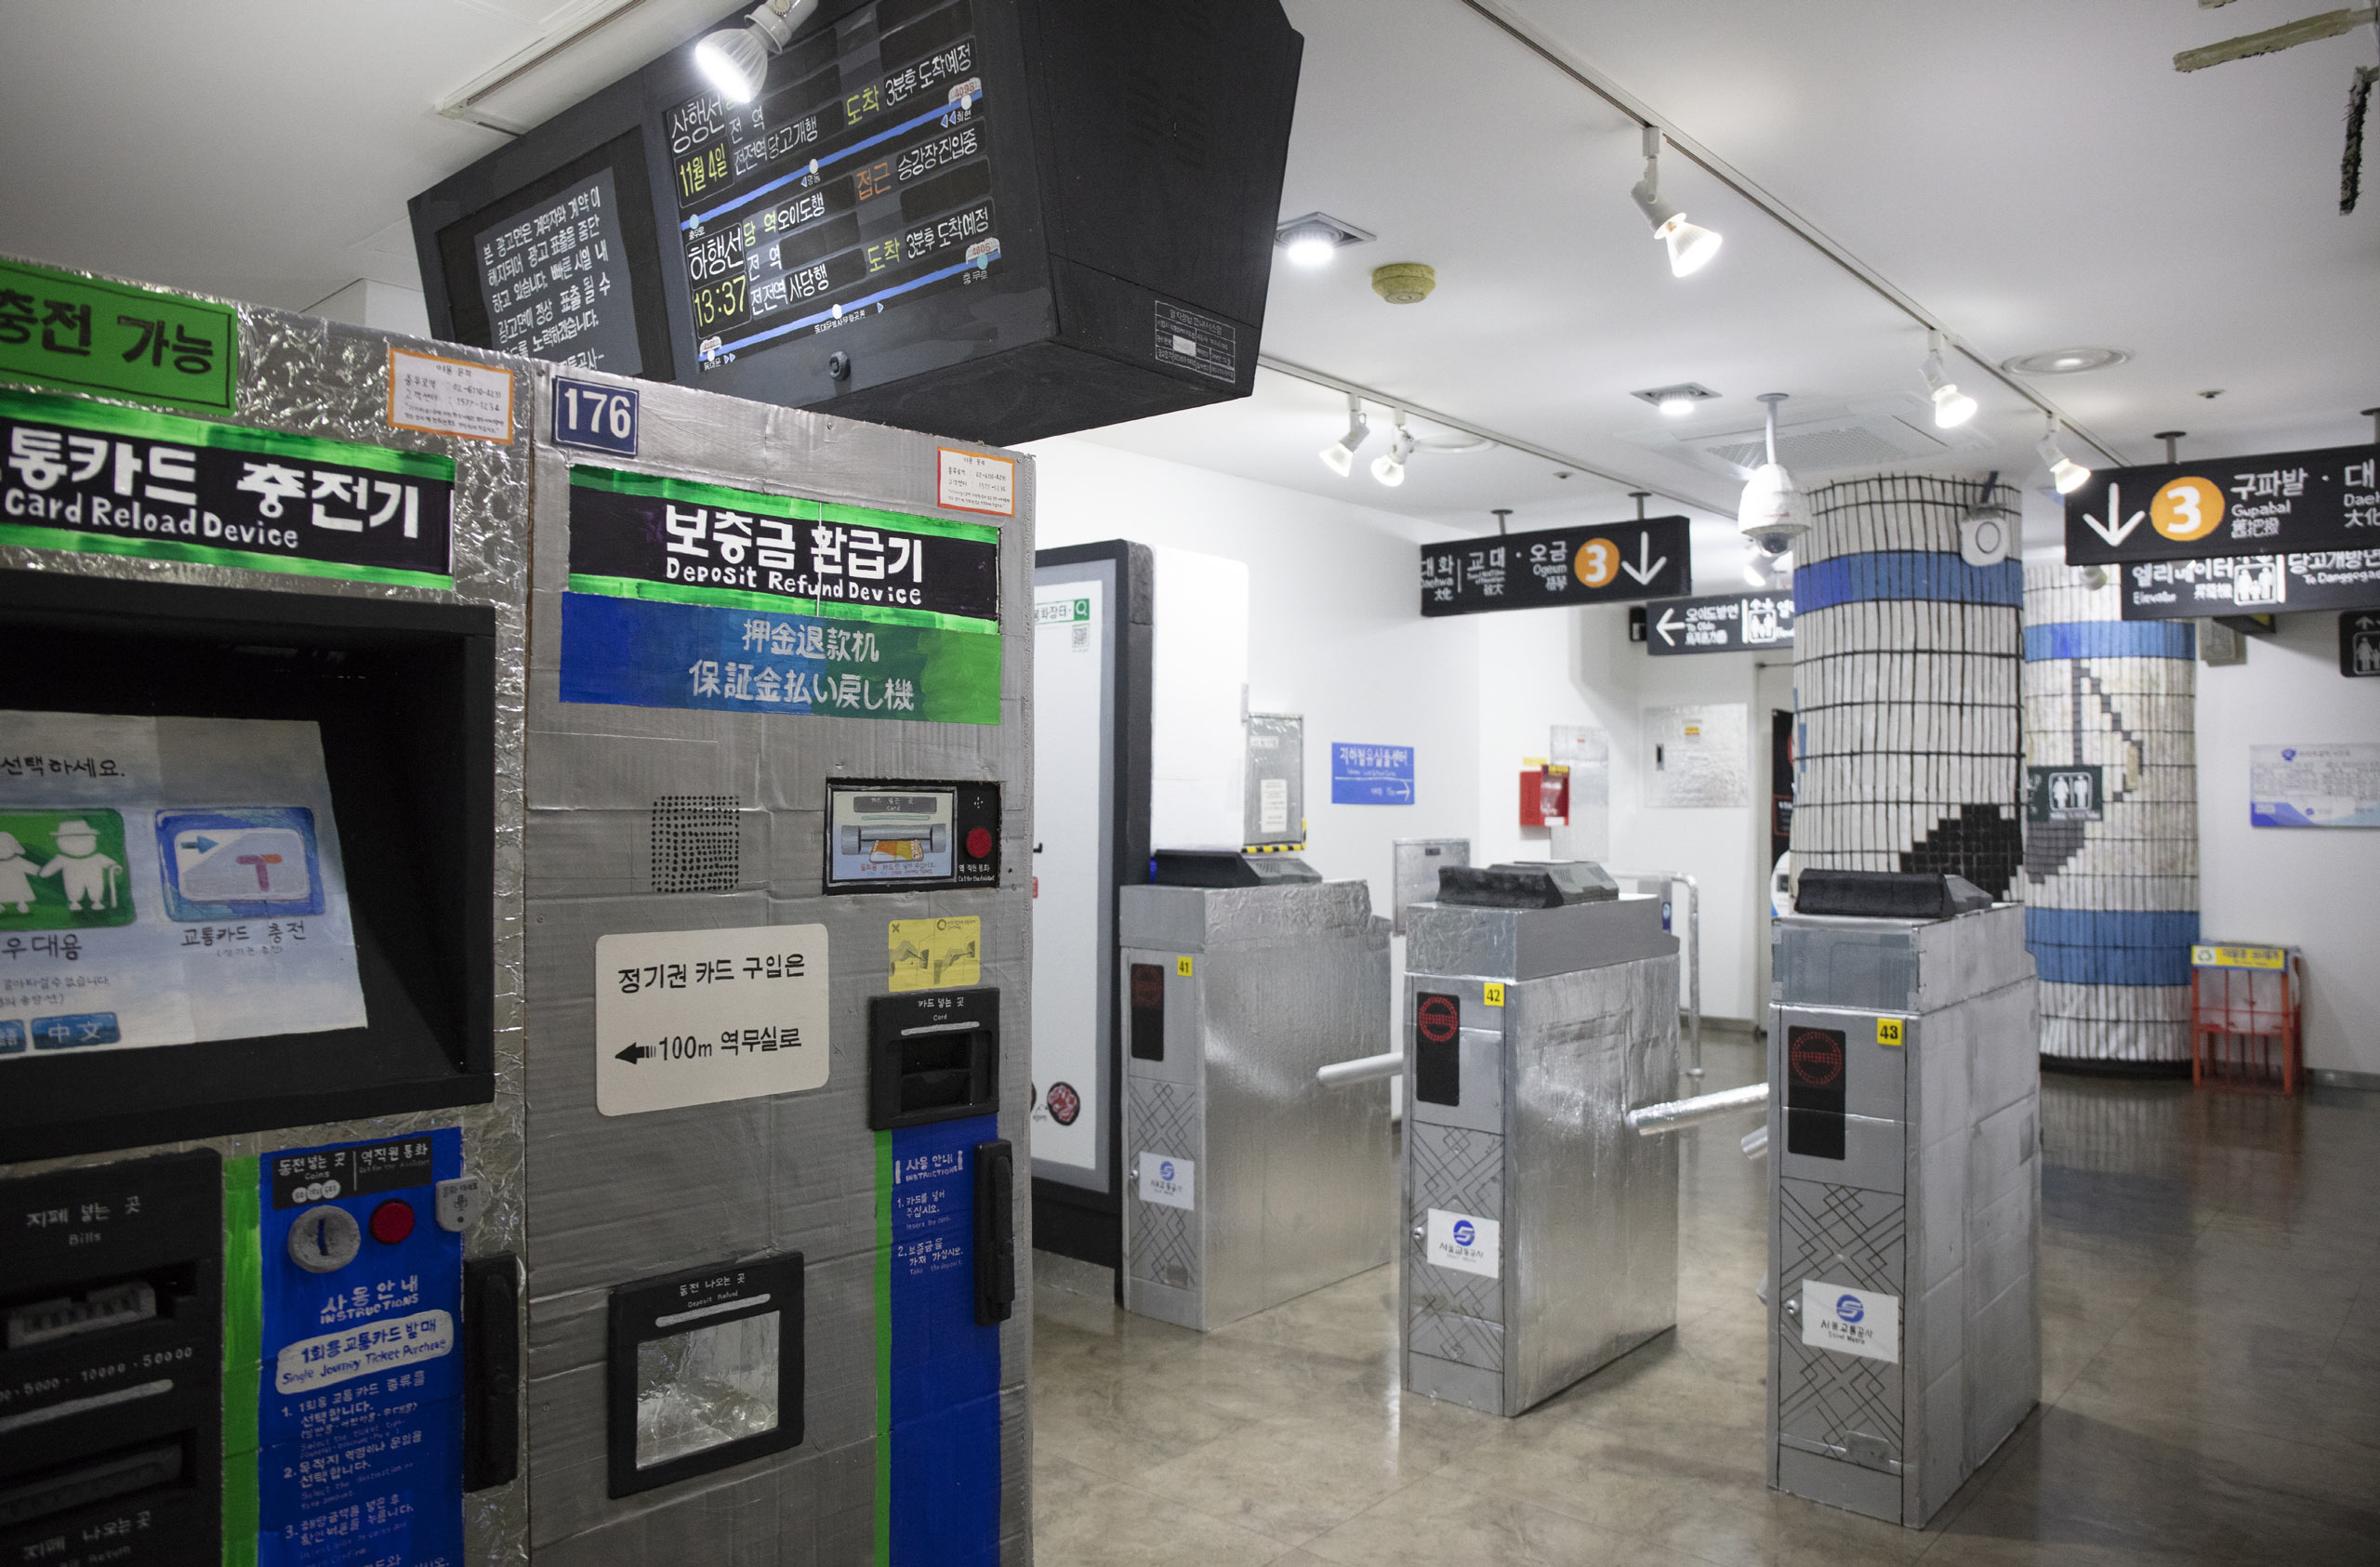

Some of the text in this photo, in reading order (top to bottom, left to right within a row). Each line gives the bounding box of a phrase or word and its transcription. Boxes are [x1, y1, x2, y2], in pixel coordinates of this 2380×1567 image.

[671, 93, 725, 154] 상행선
[752, 105, 765, 129] 역
[846, 85, 879, 125] 도착
[856, 162, 892, 201] 접근
[764, 210, 776, 233] 역
[778, 191, 826, 230] 오이도행
[528, 241, 549, 268] 광고
[578, 214, 601, 242] 중단
[688, 227, 744, 281] 하행선
[769, 244, 782, 270] 역
[868, 238, 900, 272] 도착
[492, 290, 512, 313] 하고
[550, 256, 574, 281] 빠른
[594, 239, 609, 262] 내
[789, 264, 829, 303] 사당행
[536, 298, 553, 325] 정상
[599, 272, 611, 296] 수
[694, 275, 747, 327] 13:37
[0, 287, 213, 375] 충전 가능
[562, 387, 632, 440] 176
[236, 462, 418, 539] 충전기
[2230, 467, 2307, 501] 구파발
[5, 487, 299, 548] Card Reload Device
[2166, 485, 2202, 534] 3
[2230, 500, 2292, 520] Gupabal
[666, 503, 922, 583] 보증금 환급기
[1466, 546, 1506, 573] 교대
[1529, 540, 1567, 563] 오금
[666, 557, 922, 605] Deposit Refund Device
[1533, 563, 1567, 578] Ogeum
[1584, 544, 1608, 584] 3
[741, 616, 880, 664] 押金退款机
[689, 658, 916, 712] 保証金払い戻し機
[180, 920, 307, 948] 교통카드 충전
[617, 953, 805, 994] 정기권 카드 구입은
[1179, 960, 1191, 975] 41
[1487, 988, 1501, 1003] 42
[932, 1013, 947, 1021] Card
[1879, 1024, 1899, 1041] 43
[659, 1026, 802, 1062] 100m 역무실로
[906, 1153, 953, 1171] 사용 안내
[68, 1231, 102, 1246] Bills
[320, 1293, 419, 1325] INSTRUCTIONS
